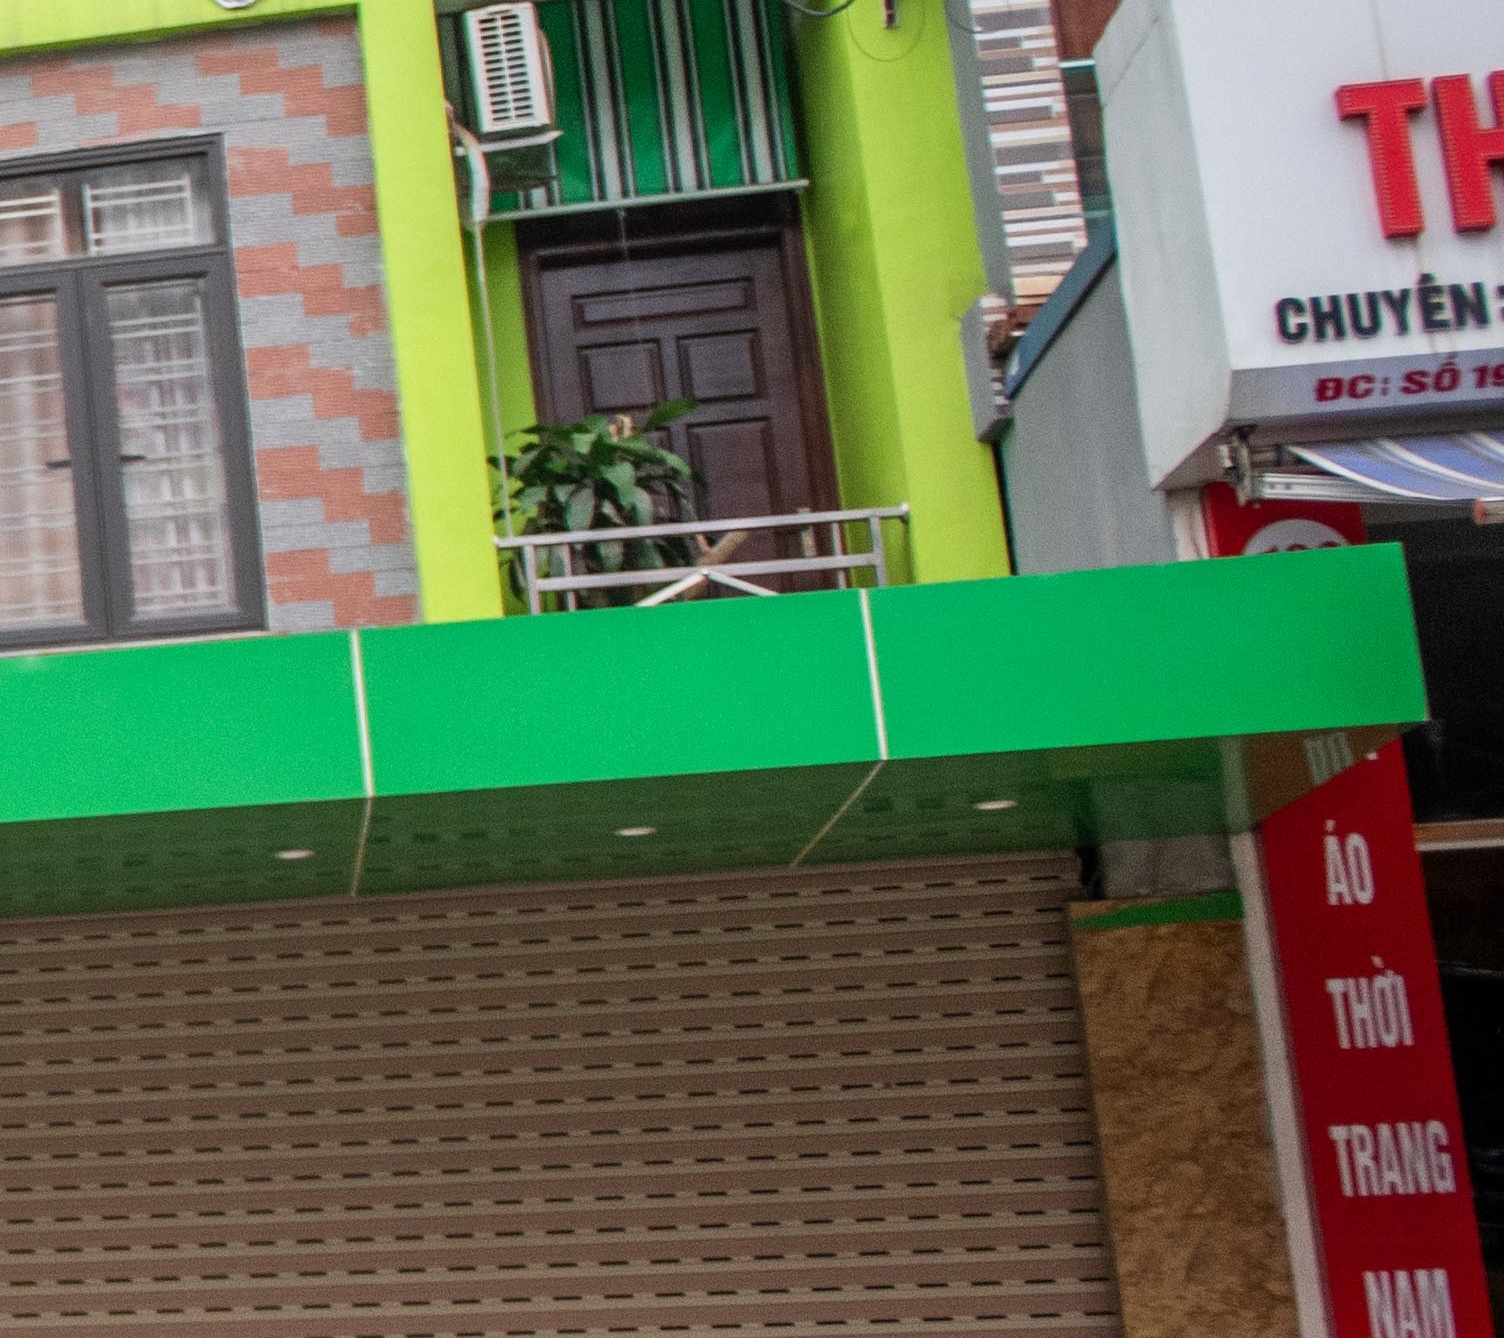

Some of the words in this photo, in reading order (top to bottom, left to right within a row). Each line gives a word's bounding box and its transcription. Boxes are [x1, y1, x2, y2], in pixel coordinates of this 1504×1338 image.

[1275, 271, 1492, 345] CHUYÊN
[1401, 352, 1462, 396] SỐ
[1324, 819, 1375, 907] ÁO
[1324, 955, 1415, 1051] THỜI
[1328, 1119, 1457, 1198] TRANG
